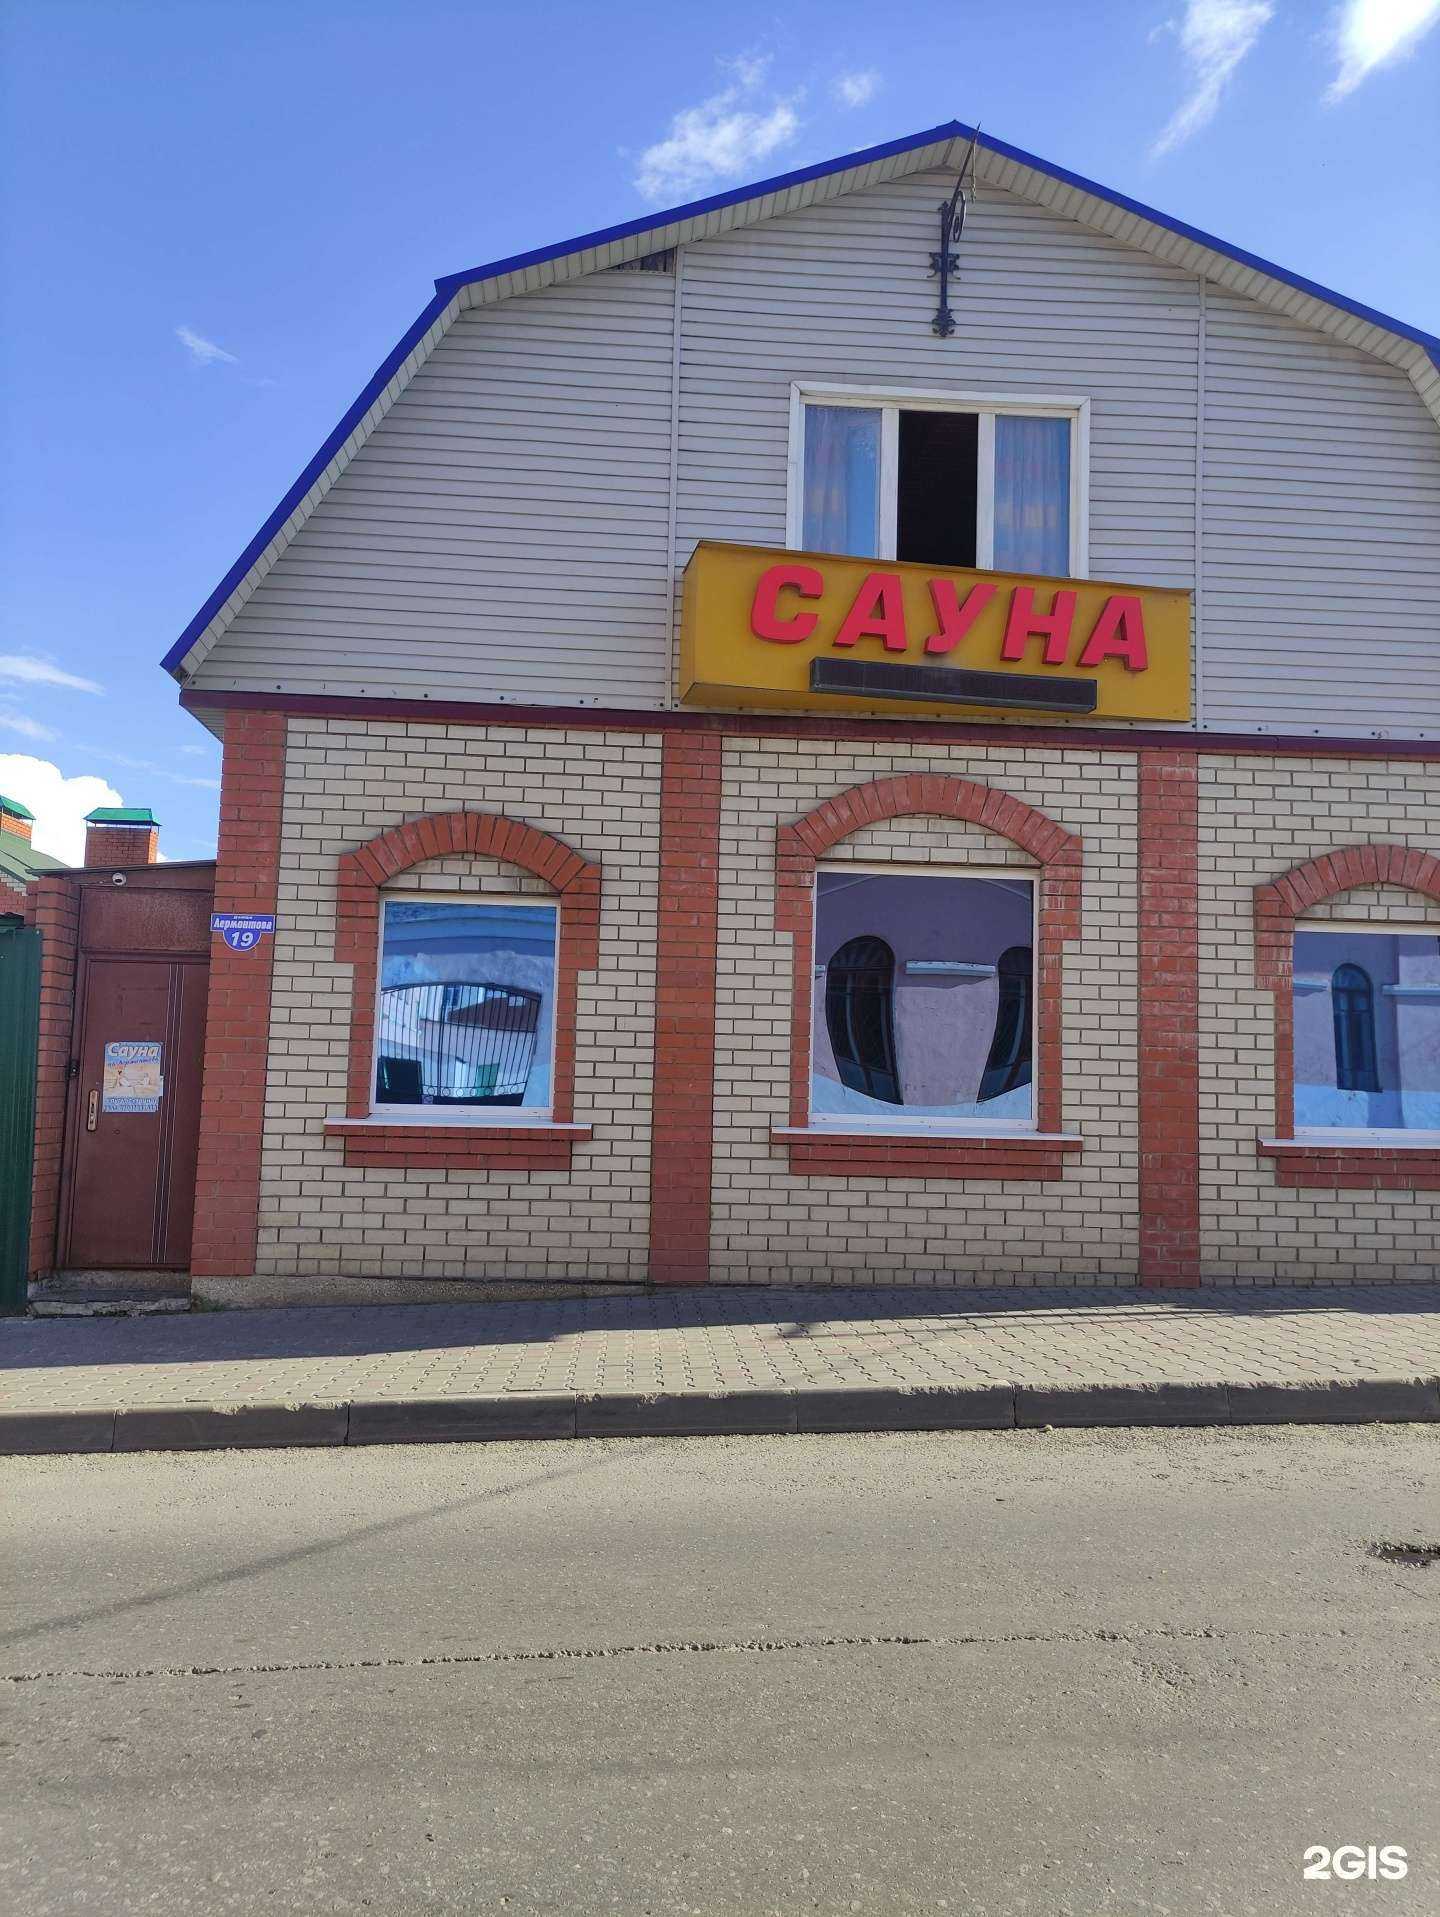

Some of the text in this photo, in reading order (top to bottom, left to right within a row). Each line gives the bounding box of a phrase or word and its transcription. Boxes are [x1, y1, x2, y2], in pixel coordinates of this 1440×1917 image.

[750, 564, 1149, 672] САУНА
[213, 917, 273, 930] Лермонтова
[231, 931, 253, 946] 19
[108, 1042, 159, 1059] Сауна
